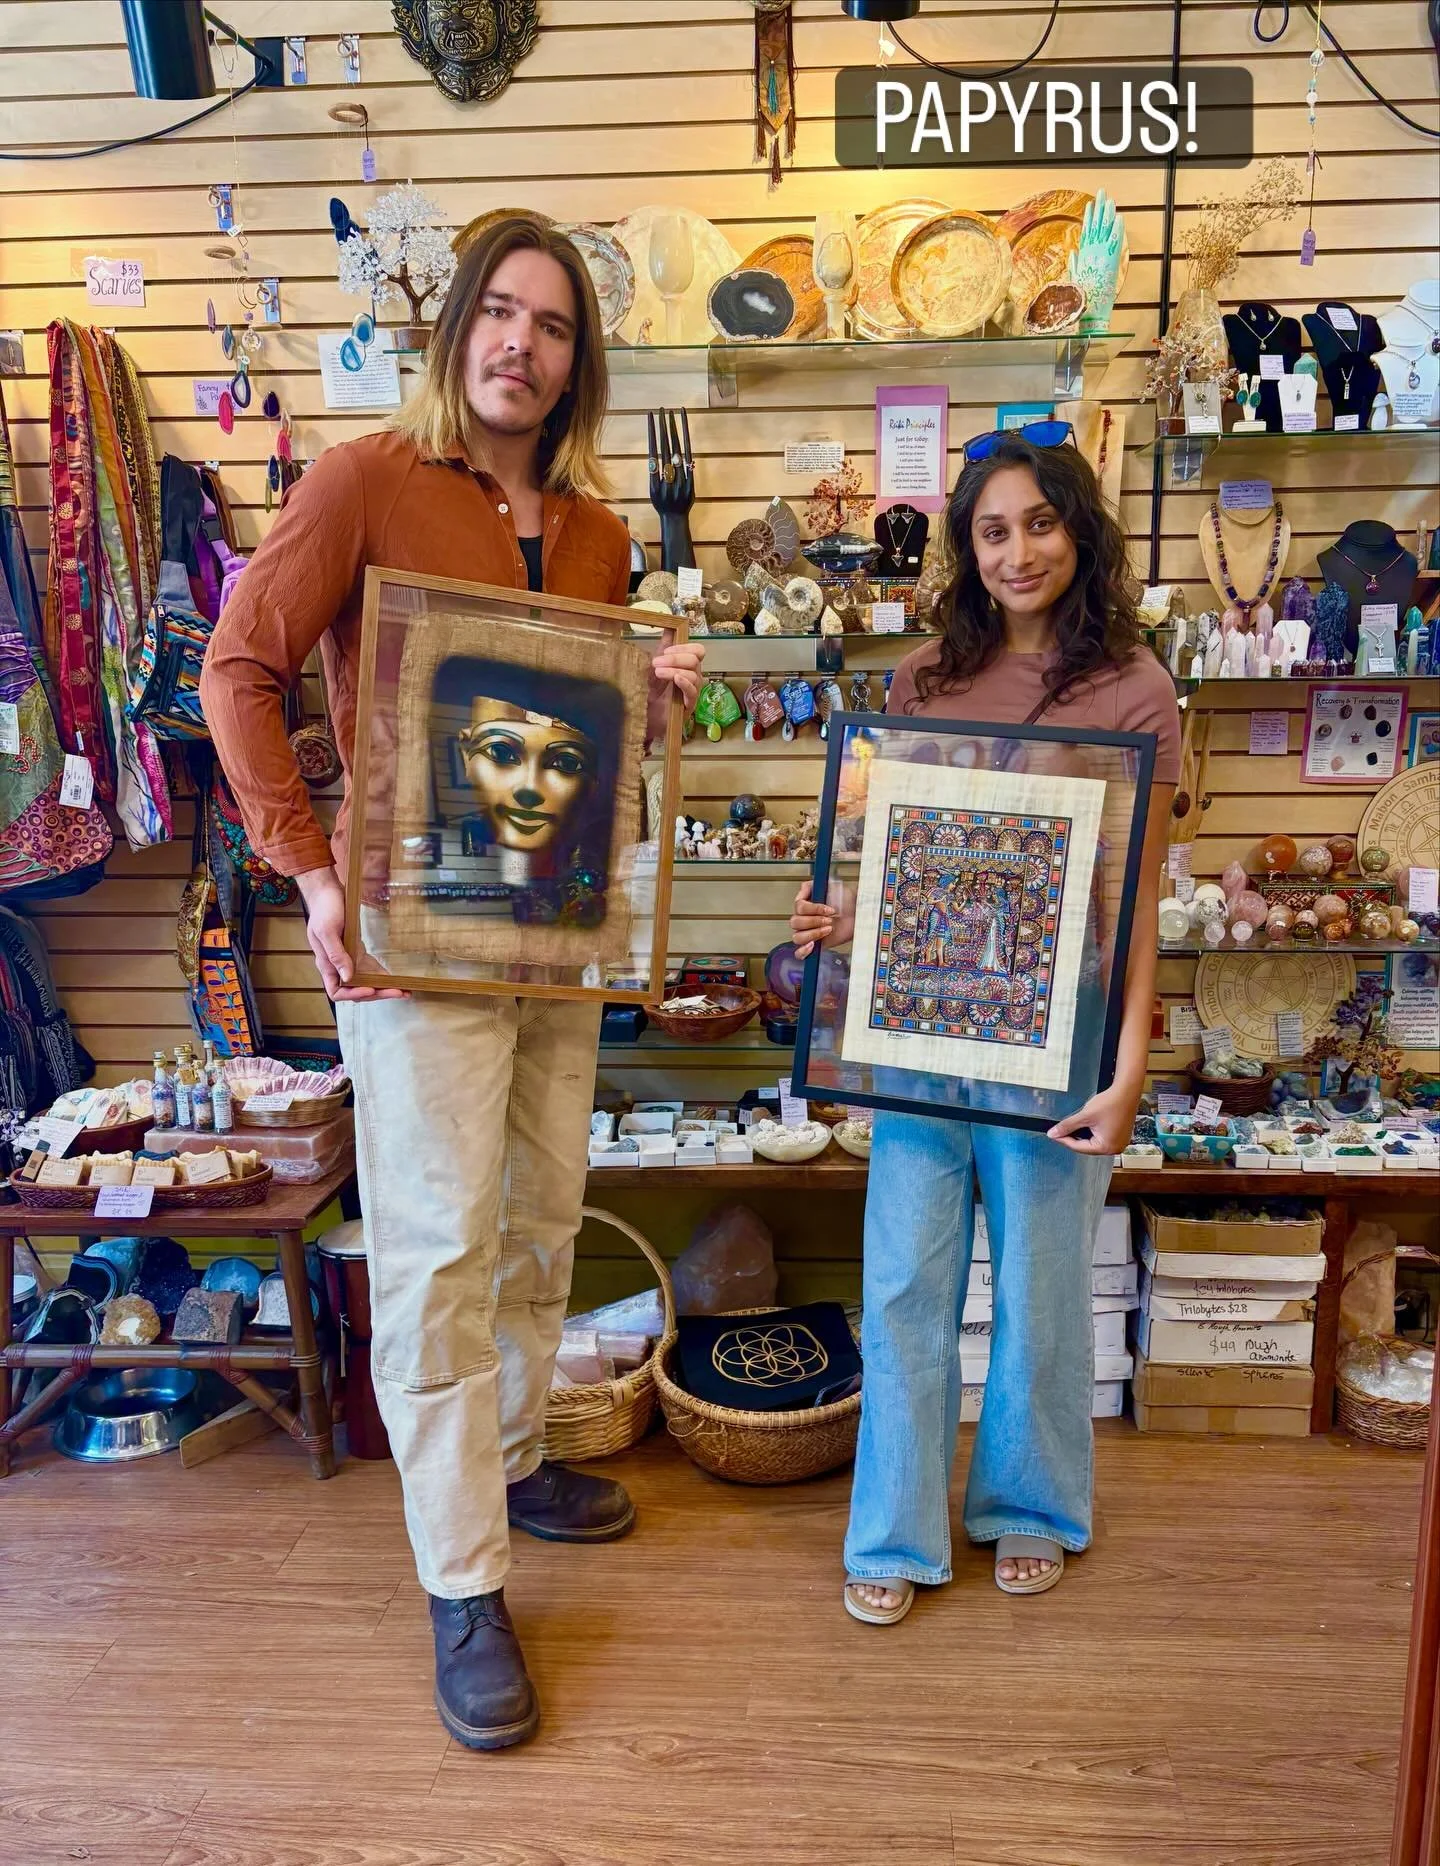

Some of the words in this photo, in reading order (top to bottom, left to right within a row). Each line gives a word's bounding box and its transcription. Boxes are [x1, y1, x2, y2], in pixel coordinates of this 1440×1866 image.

[121, 260, 139, 277] $33
[89, 266, 142, 296] Scarves
[197, 384, 219, 393] Fanny
[889, 418, 904, 430] Reiki
[906, 417, 935, 432] Principles
[1316, 693, 1345, 707] Recovery
[1351, 696, 1400, 705] Transformation
[1368, 793, 1399, 831] Mabon
[1204, 981, 1222, 1020] Imbolc
[1176, 1303, 1226, 1318] Trilobytes
[1227, 1302, 1248, 1314] $28
[1209, 1335, 1236, 1356] $49
